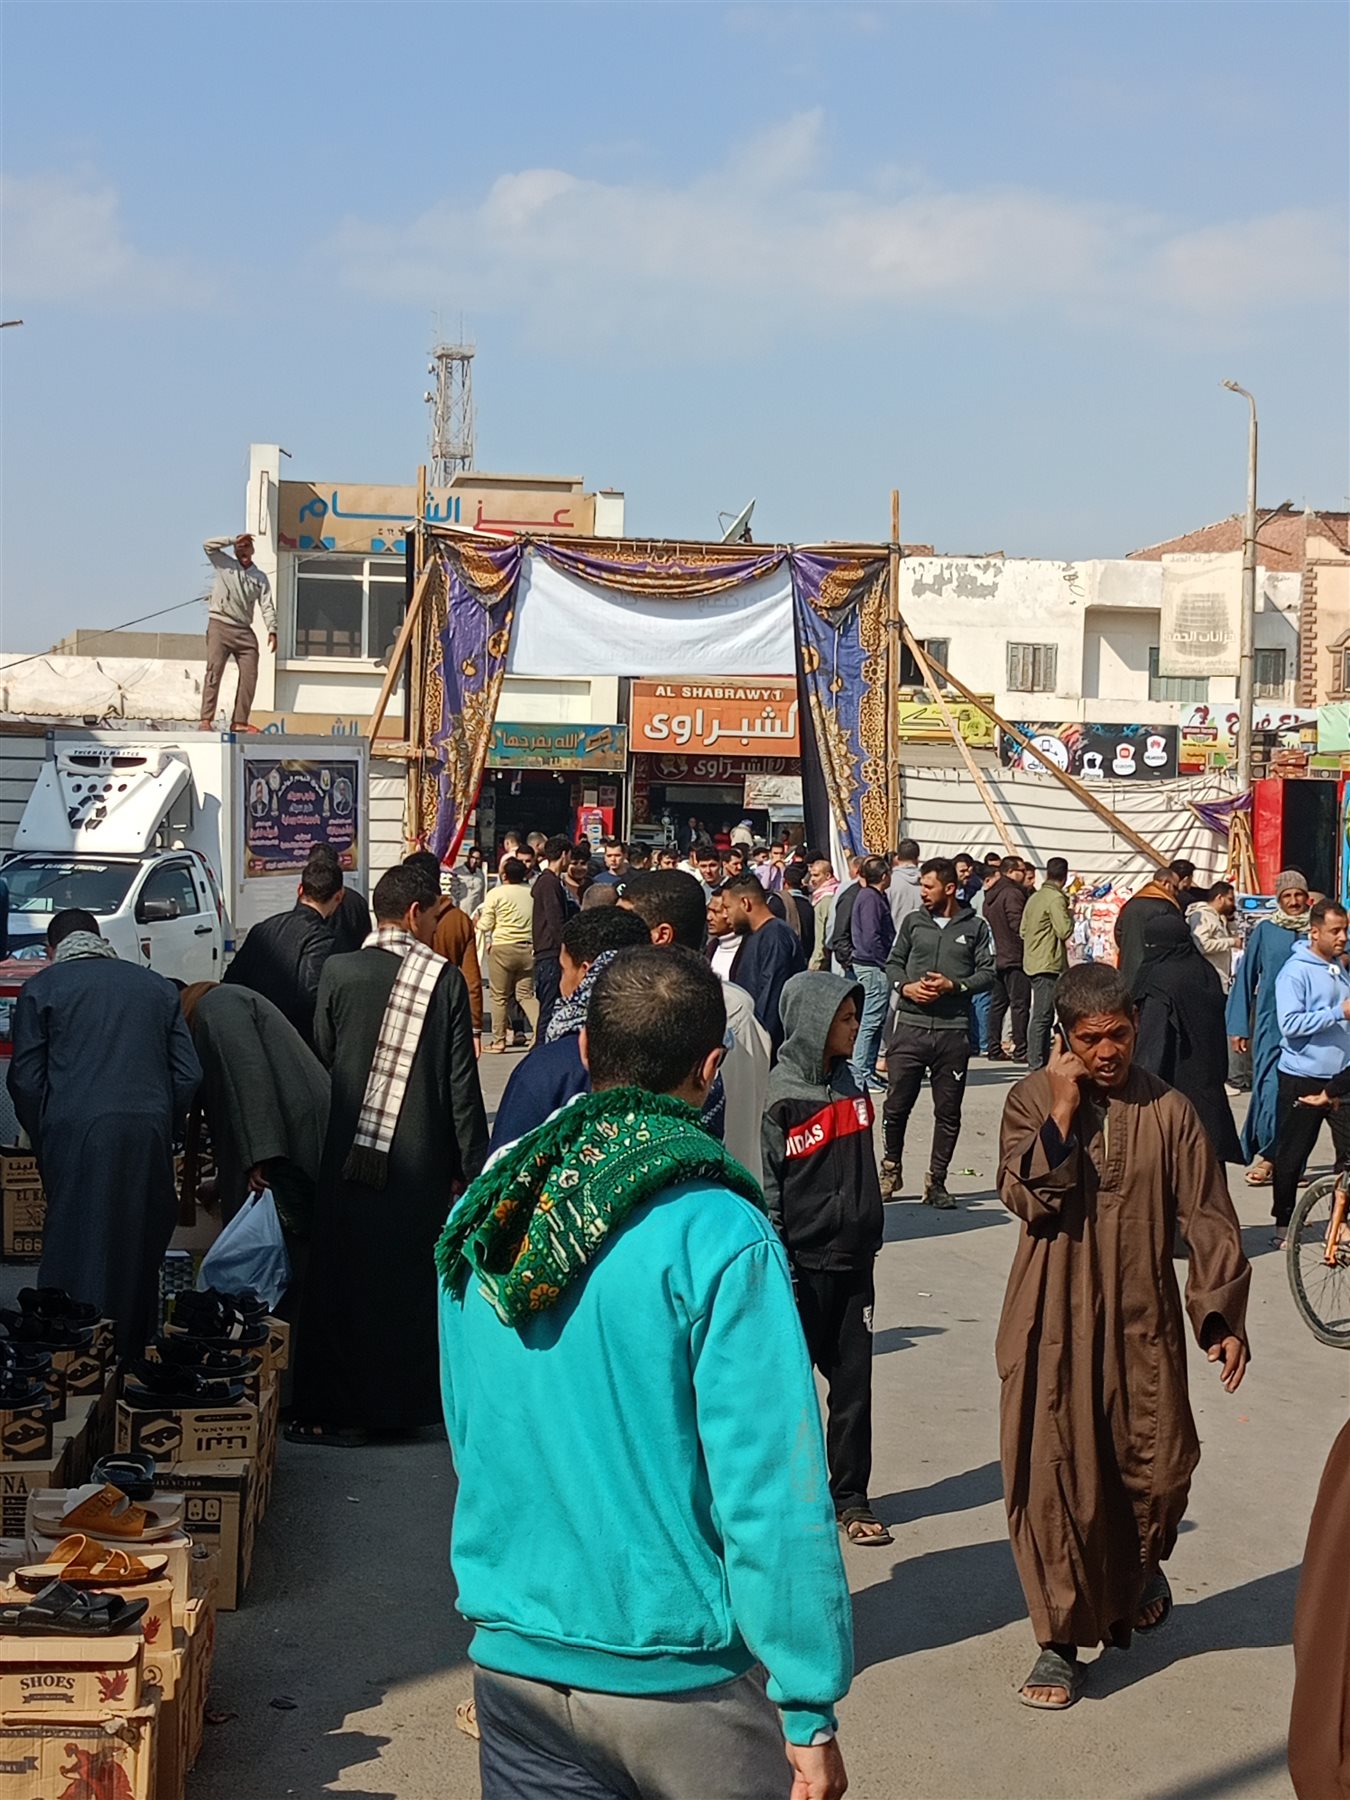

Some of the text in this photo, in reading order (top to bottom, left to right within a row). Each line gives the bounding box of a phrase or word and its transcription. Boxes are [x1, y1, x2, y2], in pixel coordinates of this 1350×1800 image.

[299, 490, 460, 524] الشام
[655, 685, 676, 698] AL
[681, 685, 771, 701] SHABRAWY
[643, 699, 798, 746] لشبراوى
[554, 733, 578, 749] الله
[196, 1433, 247, 1451] البنا
[20, 1675, 76, 1691] SHOES
